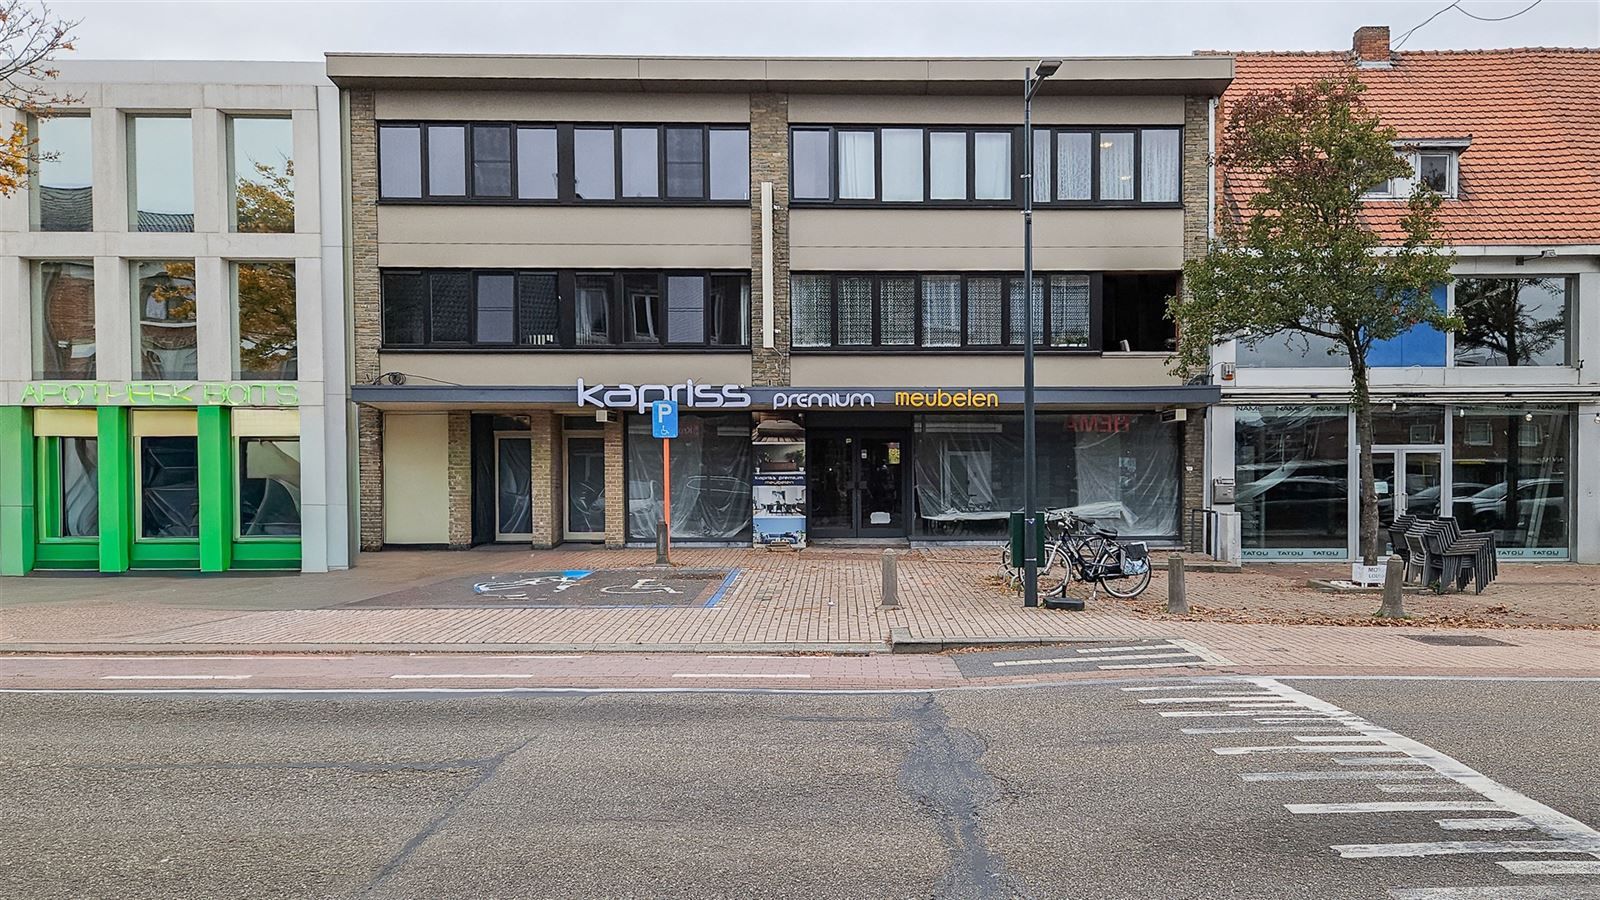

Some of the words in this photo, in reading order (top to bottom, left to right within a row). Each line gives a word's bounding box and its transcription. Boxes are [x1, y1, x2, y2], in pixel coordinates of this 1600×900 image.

[20, 384, 193, 404] APOTHEEK
[577, 378, 751, 414] kapriss
[773, 392, 875, 410] premium
[895, 388, 999, 407] meubelen
[658, 404, 672, 423] P
